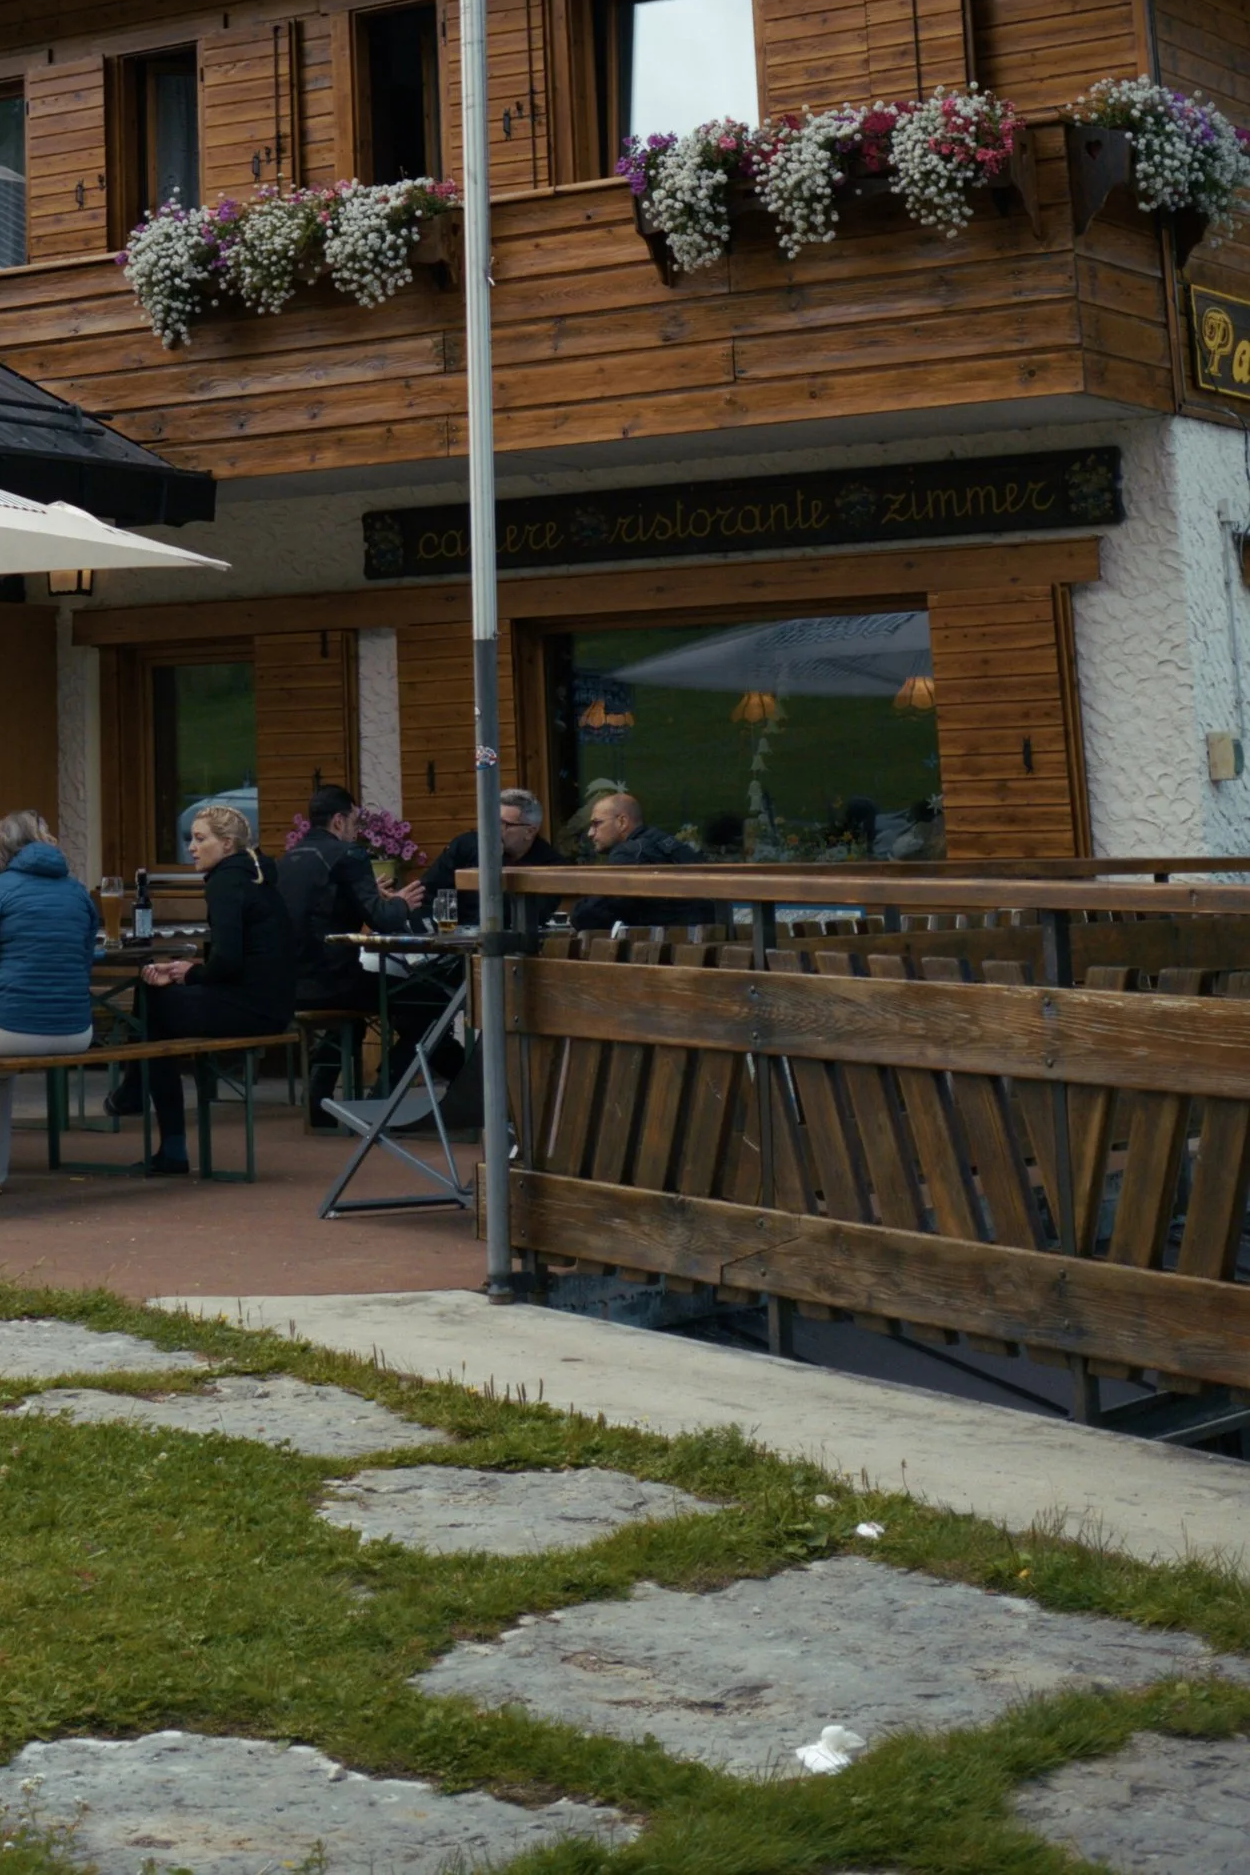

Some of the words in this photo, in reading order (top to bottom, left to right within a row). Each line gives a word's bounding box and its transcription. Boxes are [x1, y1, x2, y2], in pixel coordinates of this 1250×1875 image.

[416, 520, 565, 560] caere
[606, 489, 831, 545] ristorante
[881, 479, 1057, 524] zimmer
